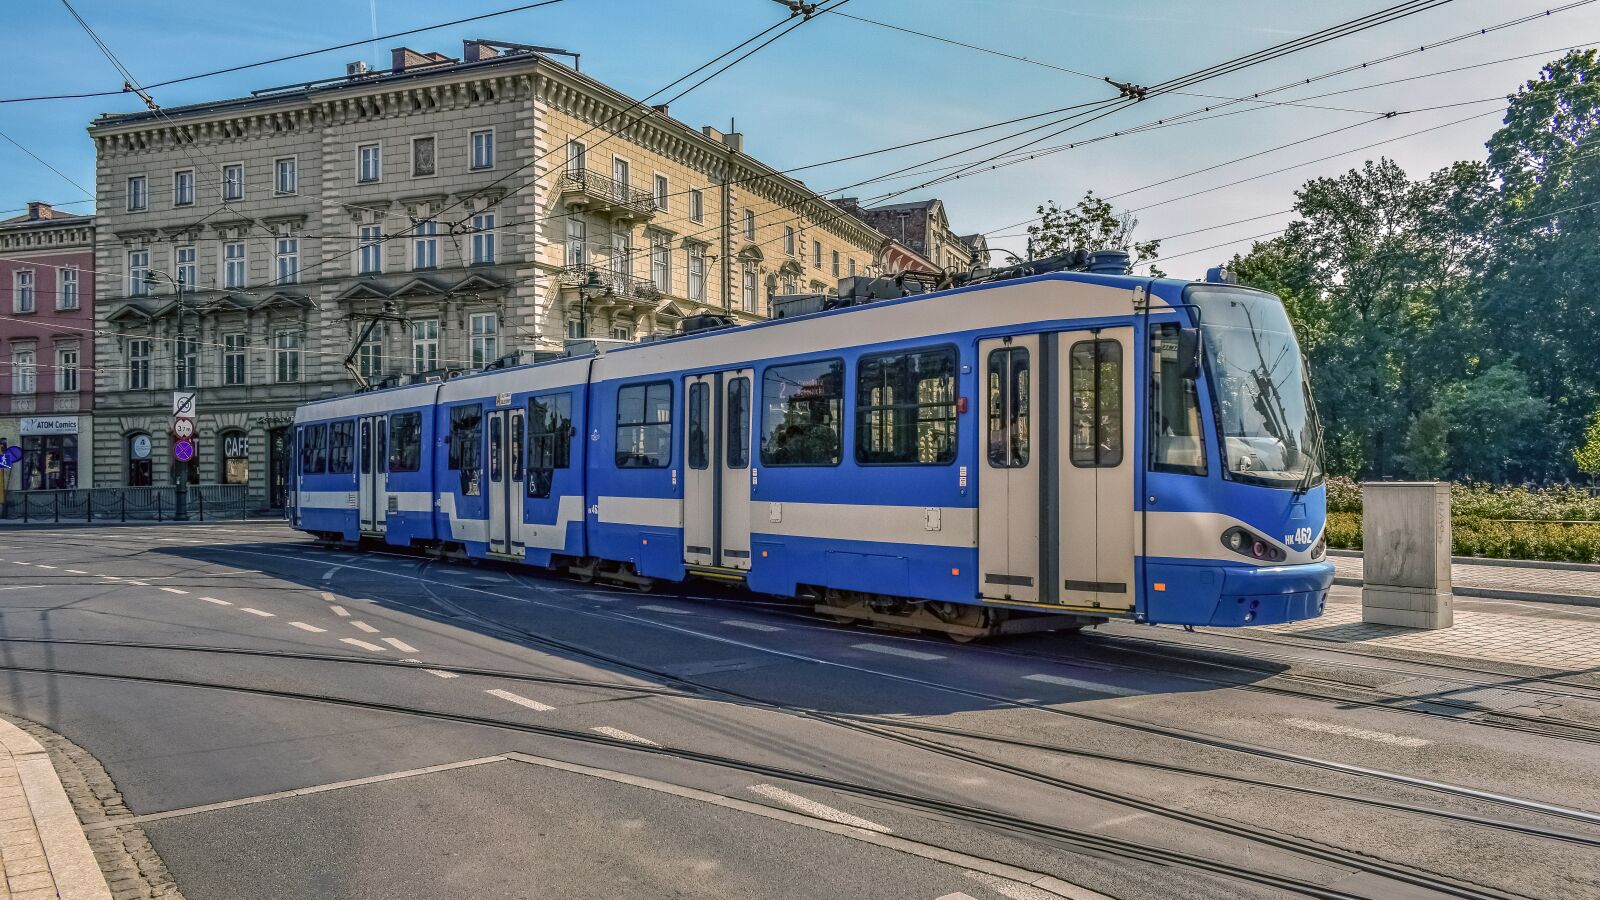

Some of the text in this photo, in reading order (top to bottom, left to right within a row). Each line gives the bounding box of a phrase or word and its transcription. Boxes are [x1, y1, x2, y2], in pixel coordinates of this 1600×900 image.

[779, 382, 786, 399] 2
[37, 420, 77, 429] ATOM Comics
[224, 437, 249, 457] CAFE
[1284, 526, 1313, 545] HK 462
